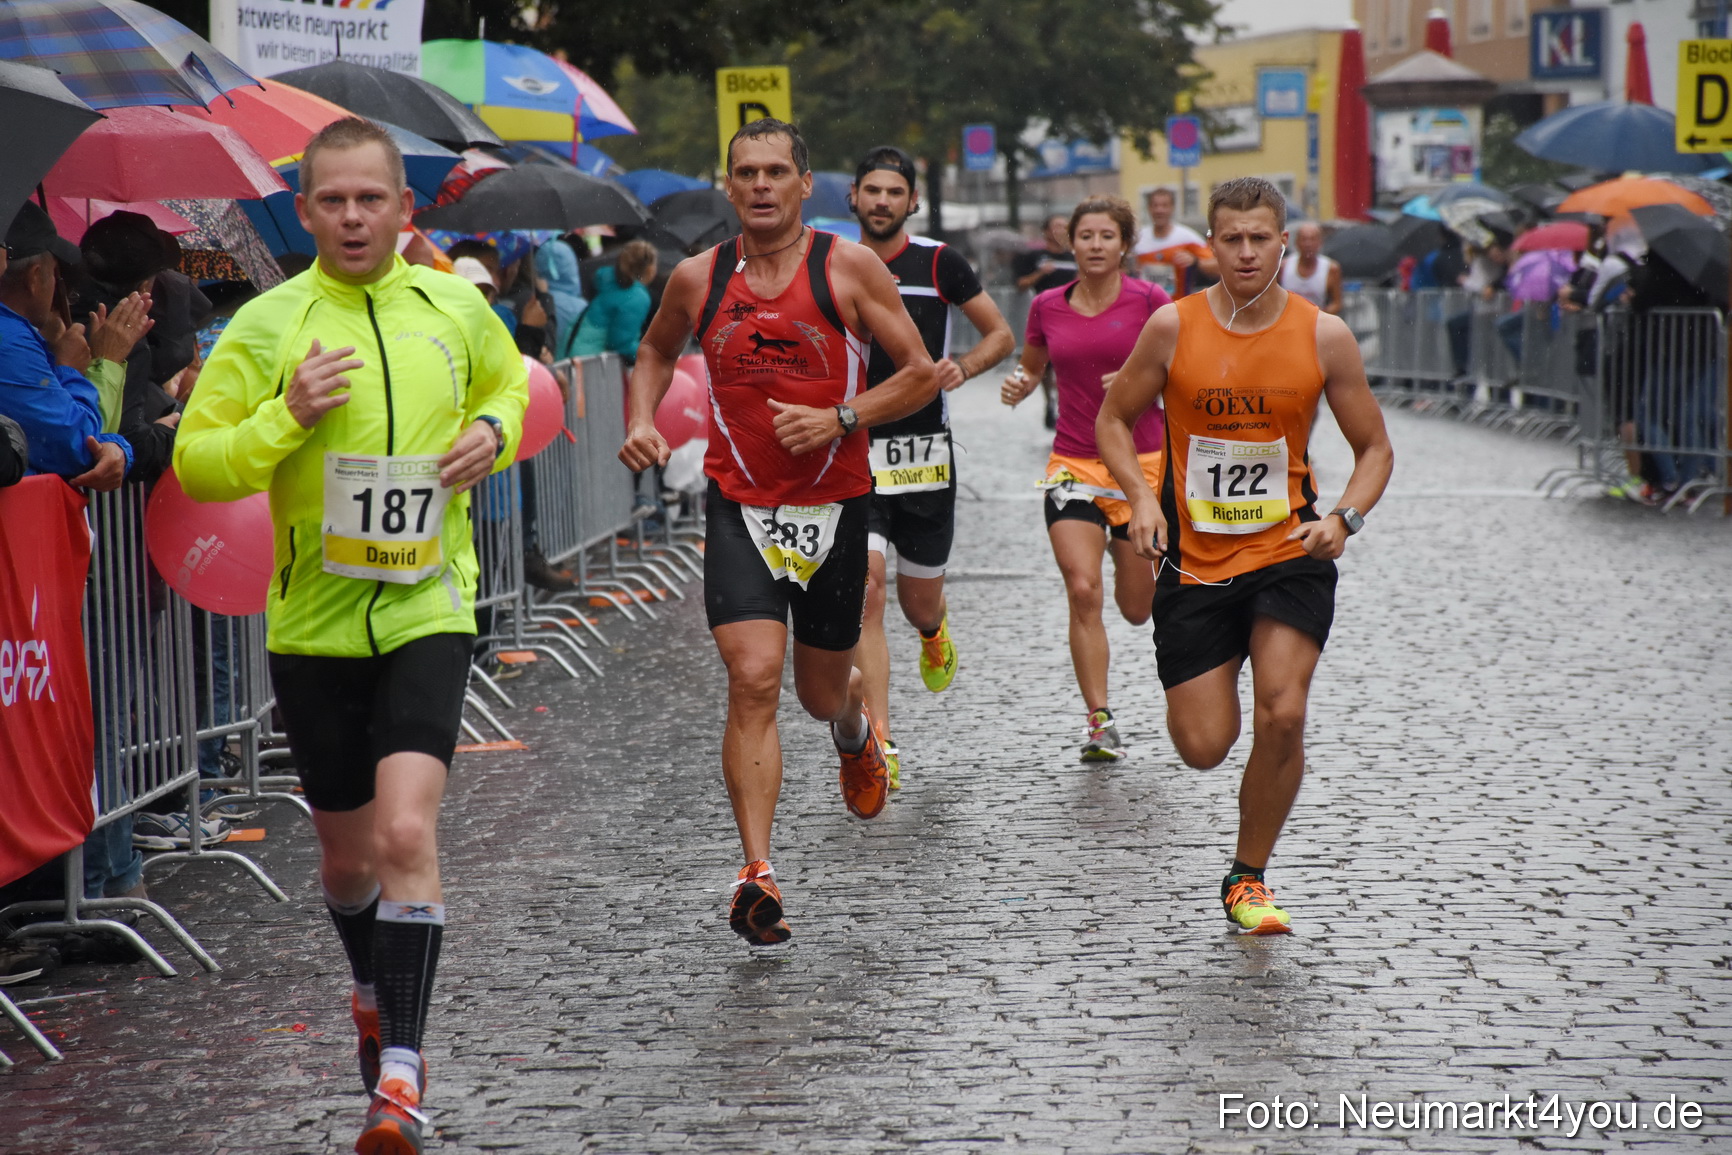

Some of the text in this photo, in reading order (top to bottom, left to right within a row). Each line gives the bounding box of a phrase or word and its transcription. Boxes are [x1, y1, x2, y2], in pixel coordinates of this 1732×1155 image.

[305, 15, 389, 41] neumarkt
[256, 41, 278, 59] wir
[1687, 44, 1732, 64] Bloc
[726, 72, 781, 93] Block
[1695, 73, 1730, 128] D
[732, 353, 808, 366] Fuchsbräu
[1205, 396, 1272, 416] OEXL
[886, 436, 934, 466] 617
[1195, 446, 1227, 457] NeuerMarkt
[1232, 444, 1280, 457] BOCK
[334, 467, 379, 479] NeuerMarkt
[1207, 463, 1269, 498] 122
[353, 488, 434, 535] 187
[1212, 505, 1264, 522] Richard
[197, 540, 225, 576] energie
[366, 546, 417, 566] David
